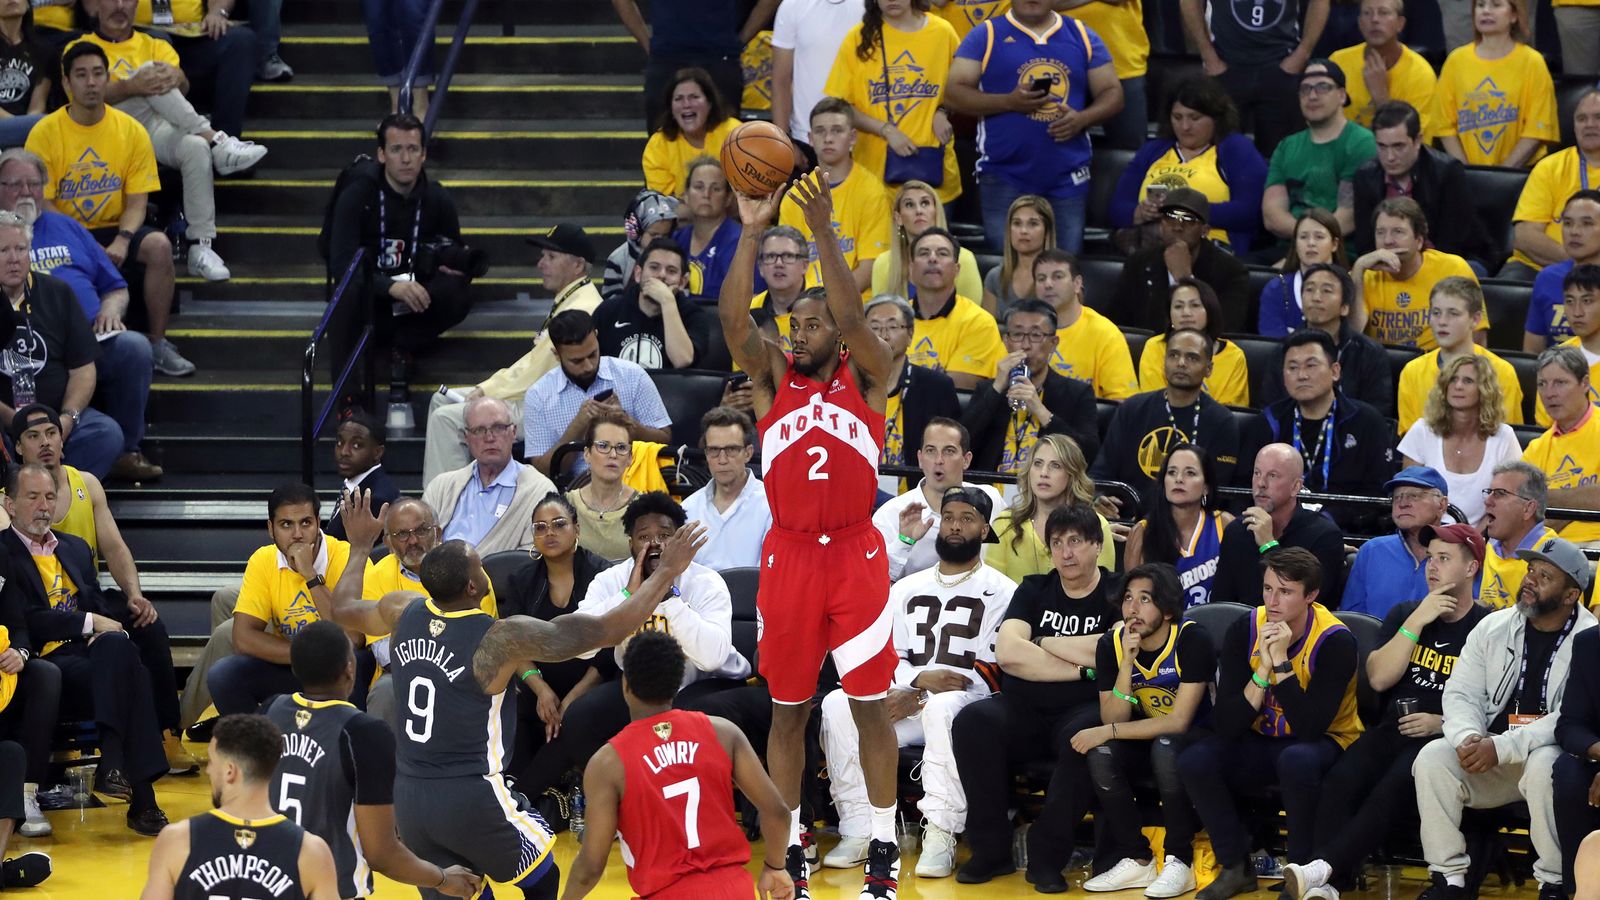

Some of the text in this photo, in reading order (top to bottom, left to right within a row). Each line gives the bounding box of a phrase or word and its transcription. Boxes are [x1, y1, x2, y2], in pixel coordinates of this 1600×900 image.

[1252, 5, 1264, 26] 9
[1017, 57, 1072, 75] GOLDEN STATE
[893, 77, 939, 98] Golden
[80, 172, 122, 191] Golde
[37, 245, 71, 260] STATE
[620, 333, 649, 347] GOLDEN
[780, 404, 858, 441] NORTH
[806, 445, 829, 480] 2
[906, 595, 985, 670] 32
[1040, 610, 1080, 635] POLO
[394, 638, 465, 683] IGUODALA
[405, 675, 436, 743] 9
[1150, 695, 1173, 707] 30
[280, 733, 326, 768] OONEY
[642, 741, 699, 774] LOWRY
[279, 772, 307, 827] 5
[662, 776, 700, 849] 7
[189, 854, 294, 897] THOMPSON
